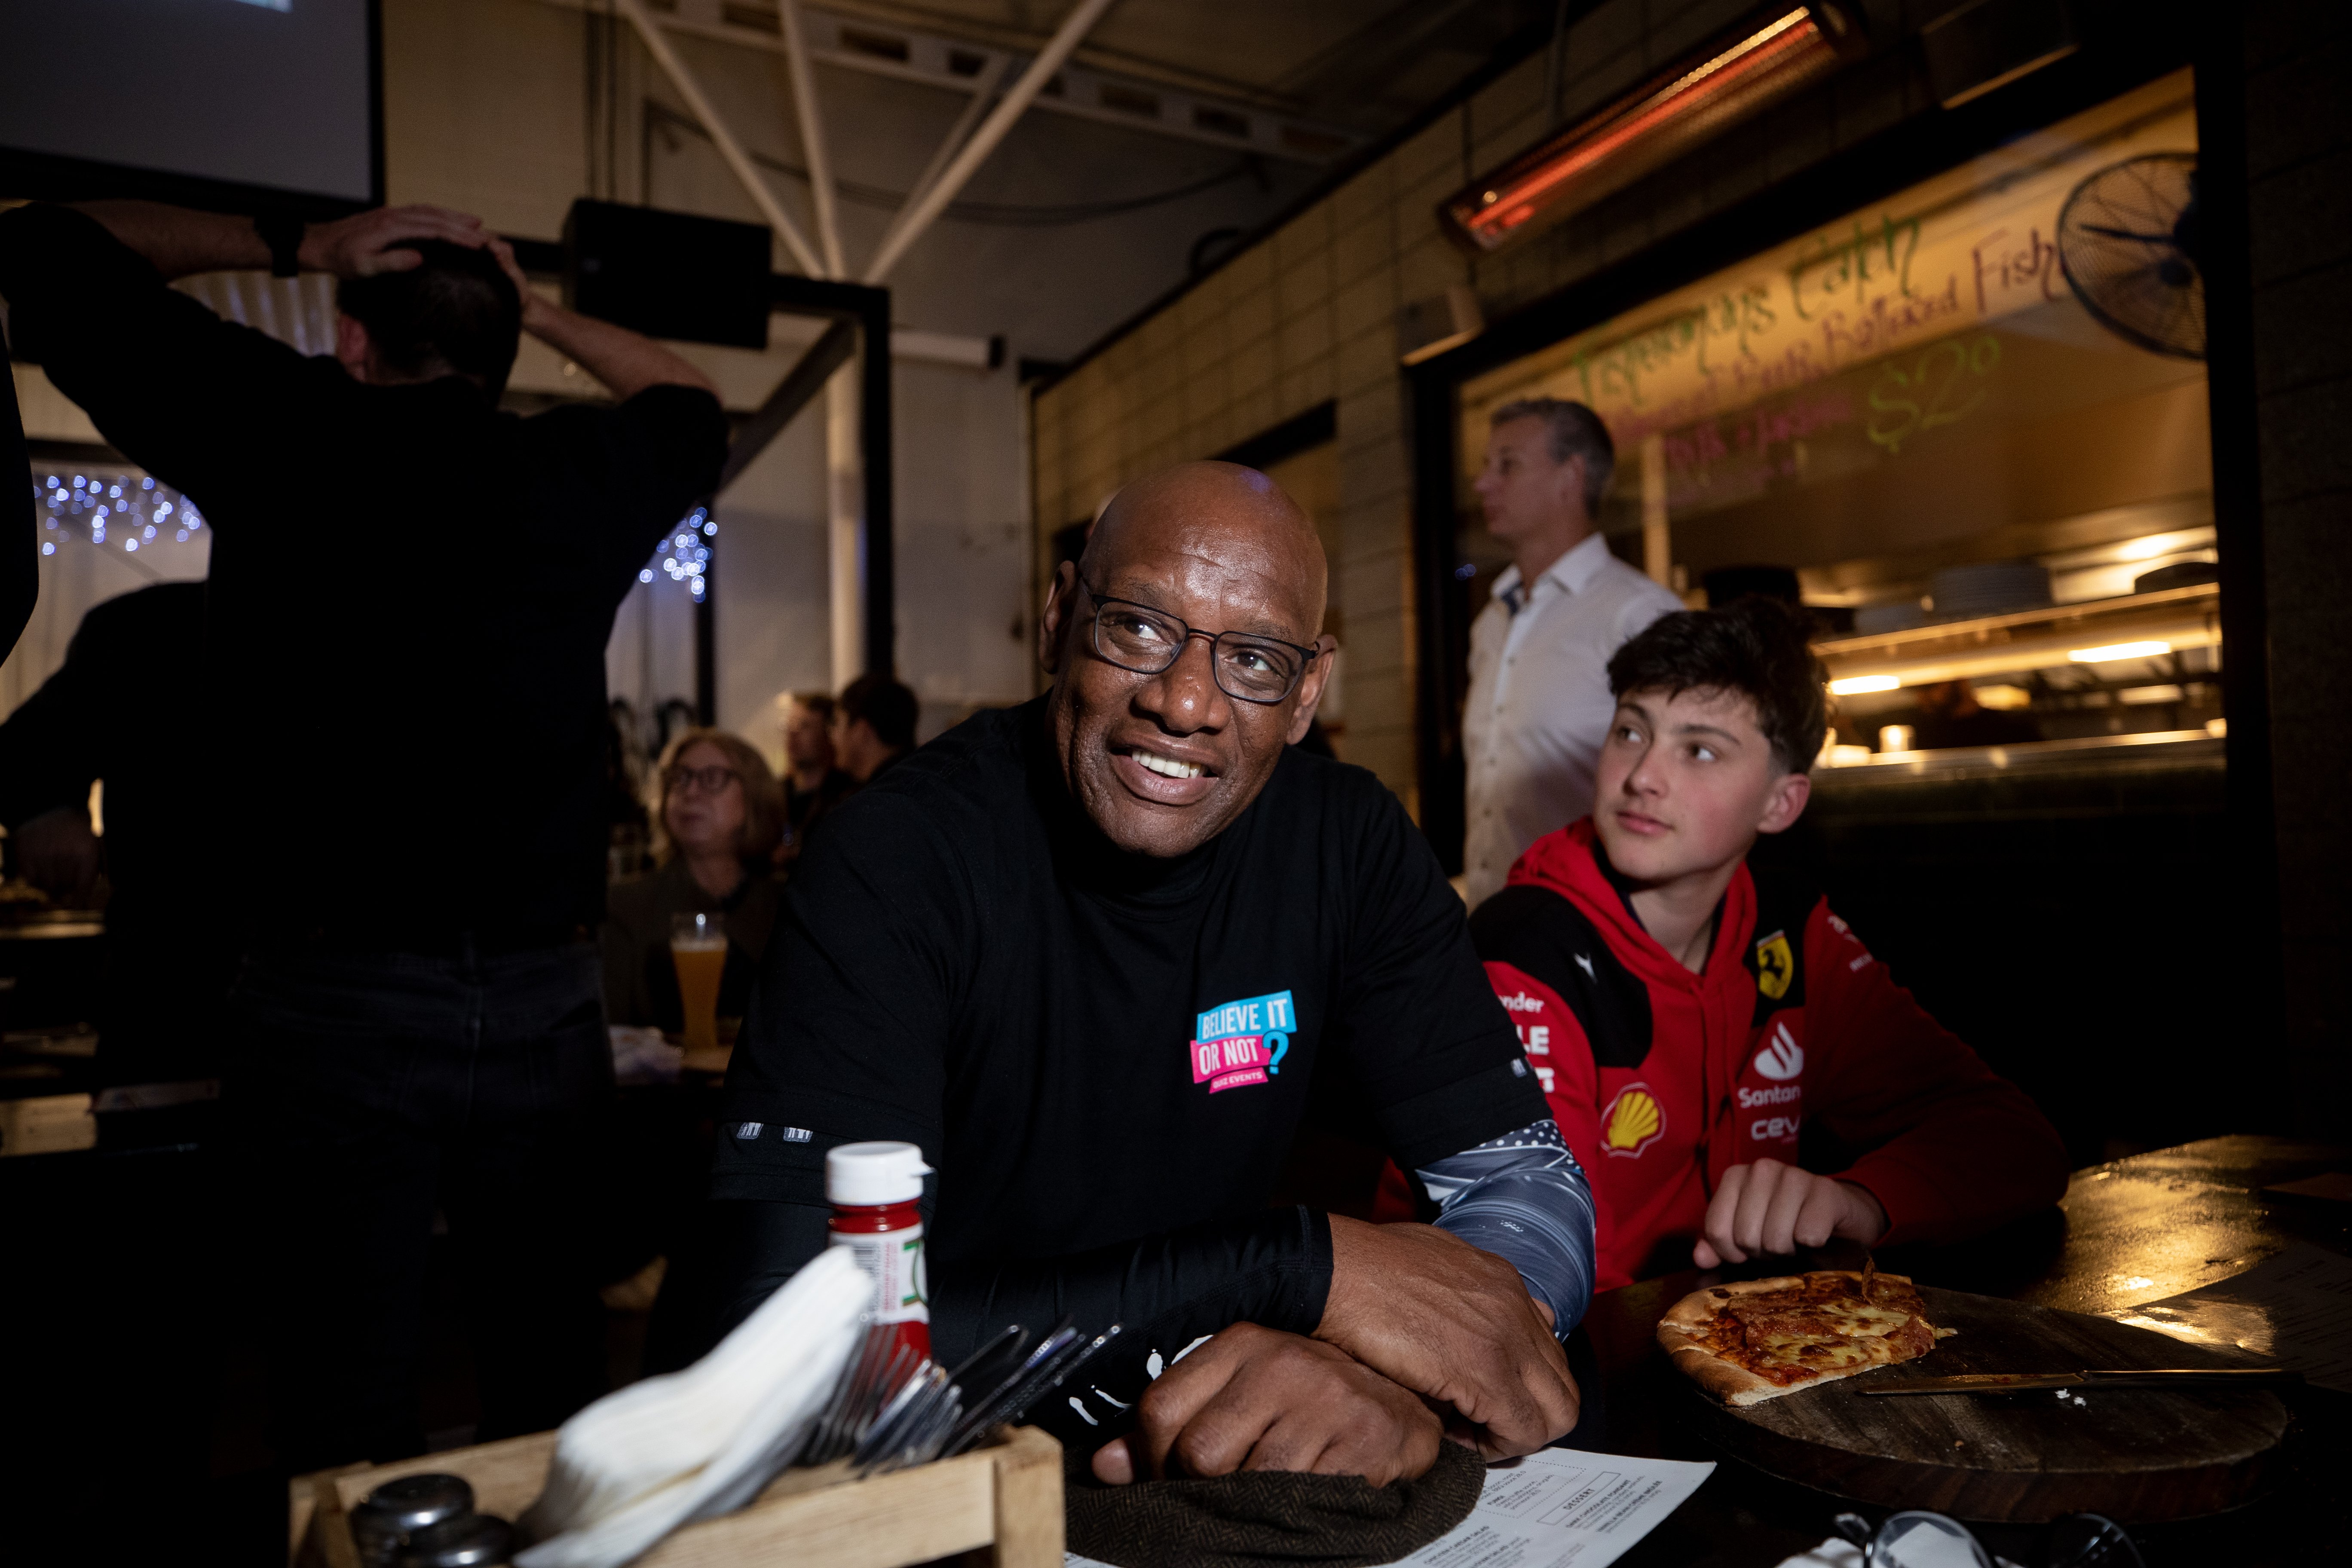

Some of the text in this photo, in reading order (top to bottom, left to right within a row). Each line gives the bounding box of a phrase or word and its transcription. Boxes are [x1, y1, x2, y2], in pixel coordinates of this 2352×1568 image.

[1788, 214, 1921, 319] Catch
[1972, 227, 2060, 314] Fish
[1202, 999, 1288, 1040] BELIEVE IT
[1198, 1044, 1221, 1076] OR
[1223, 1038, 1259, 1066] NOT
[1229, 1072, 1263, 1084] EVENTS
[1562, 1489, 1595, 1509] DESSERT
